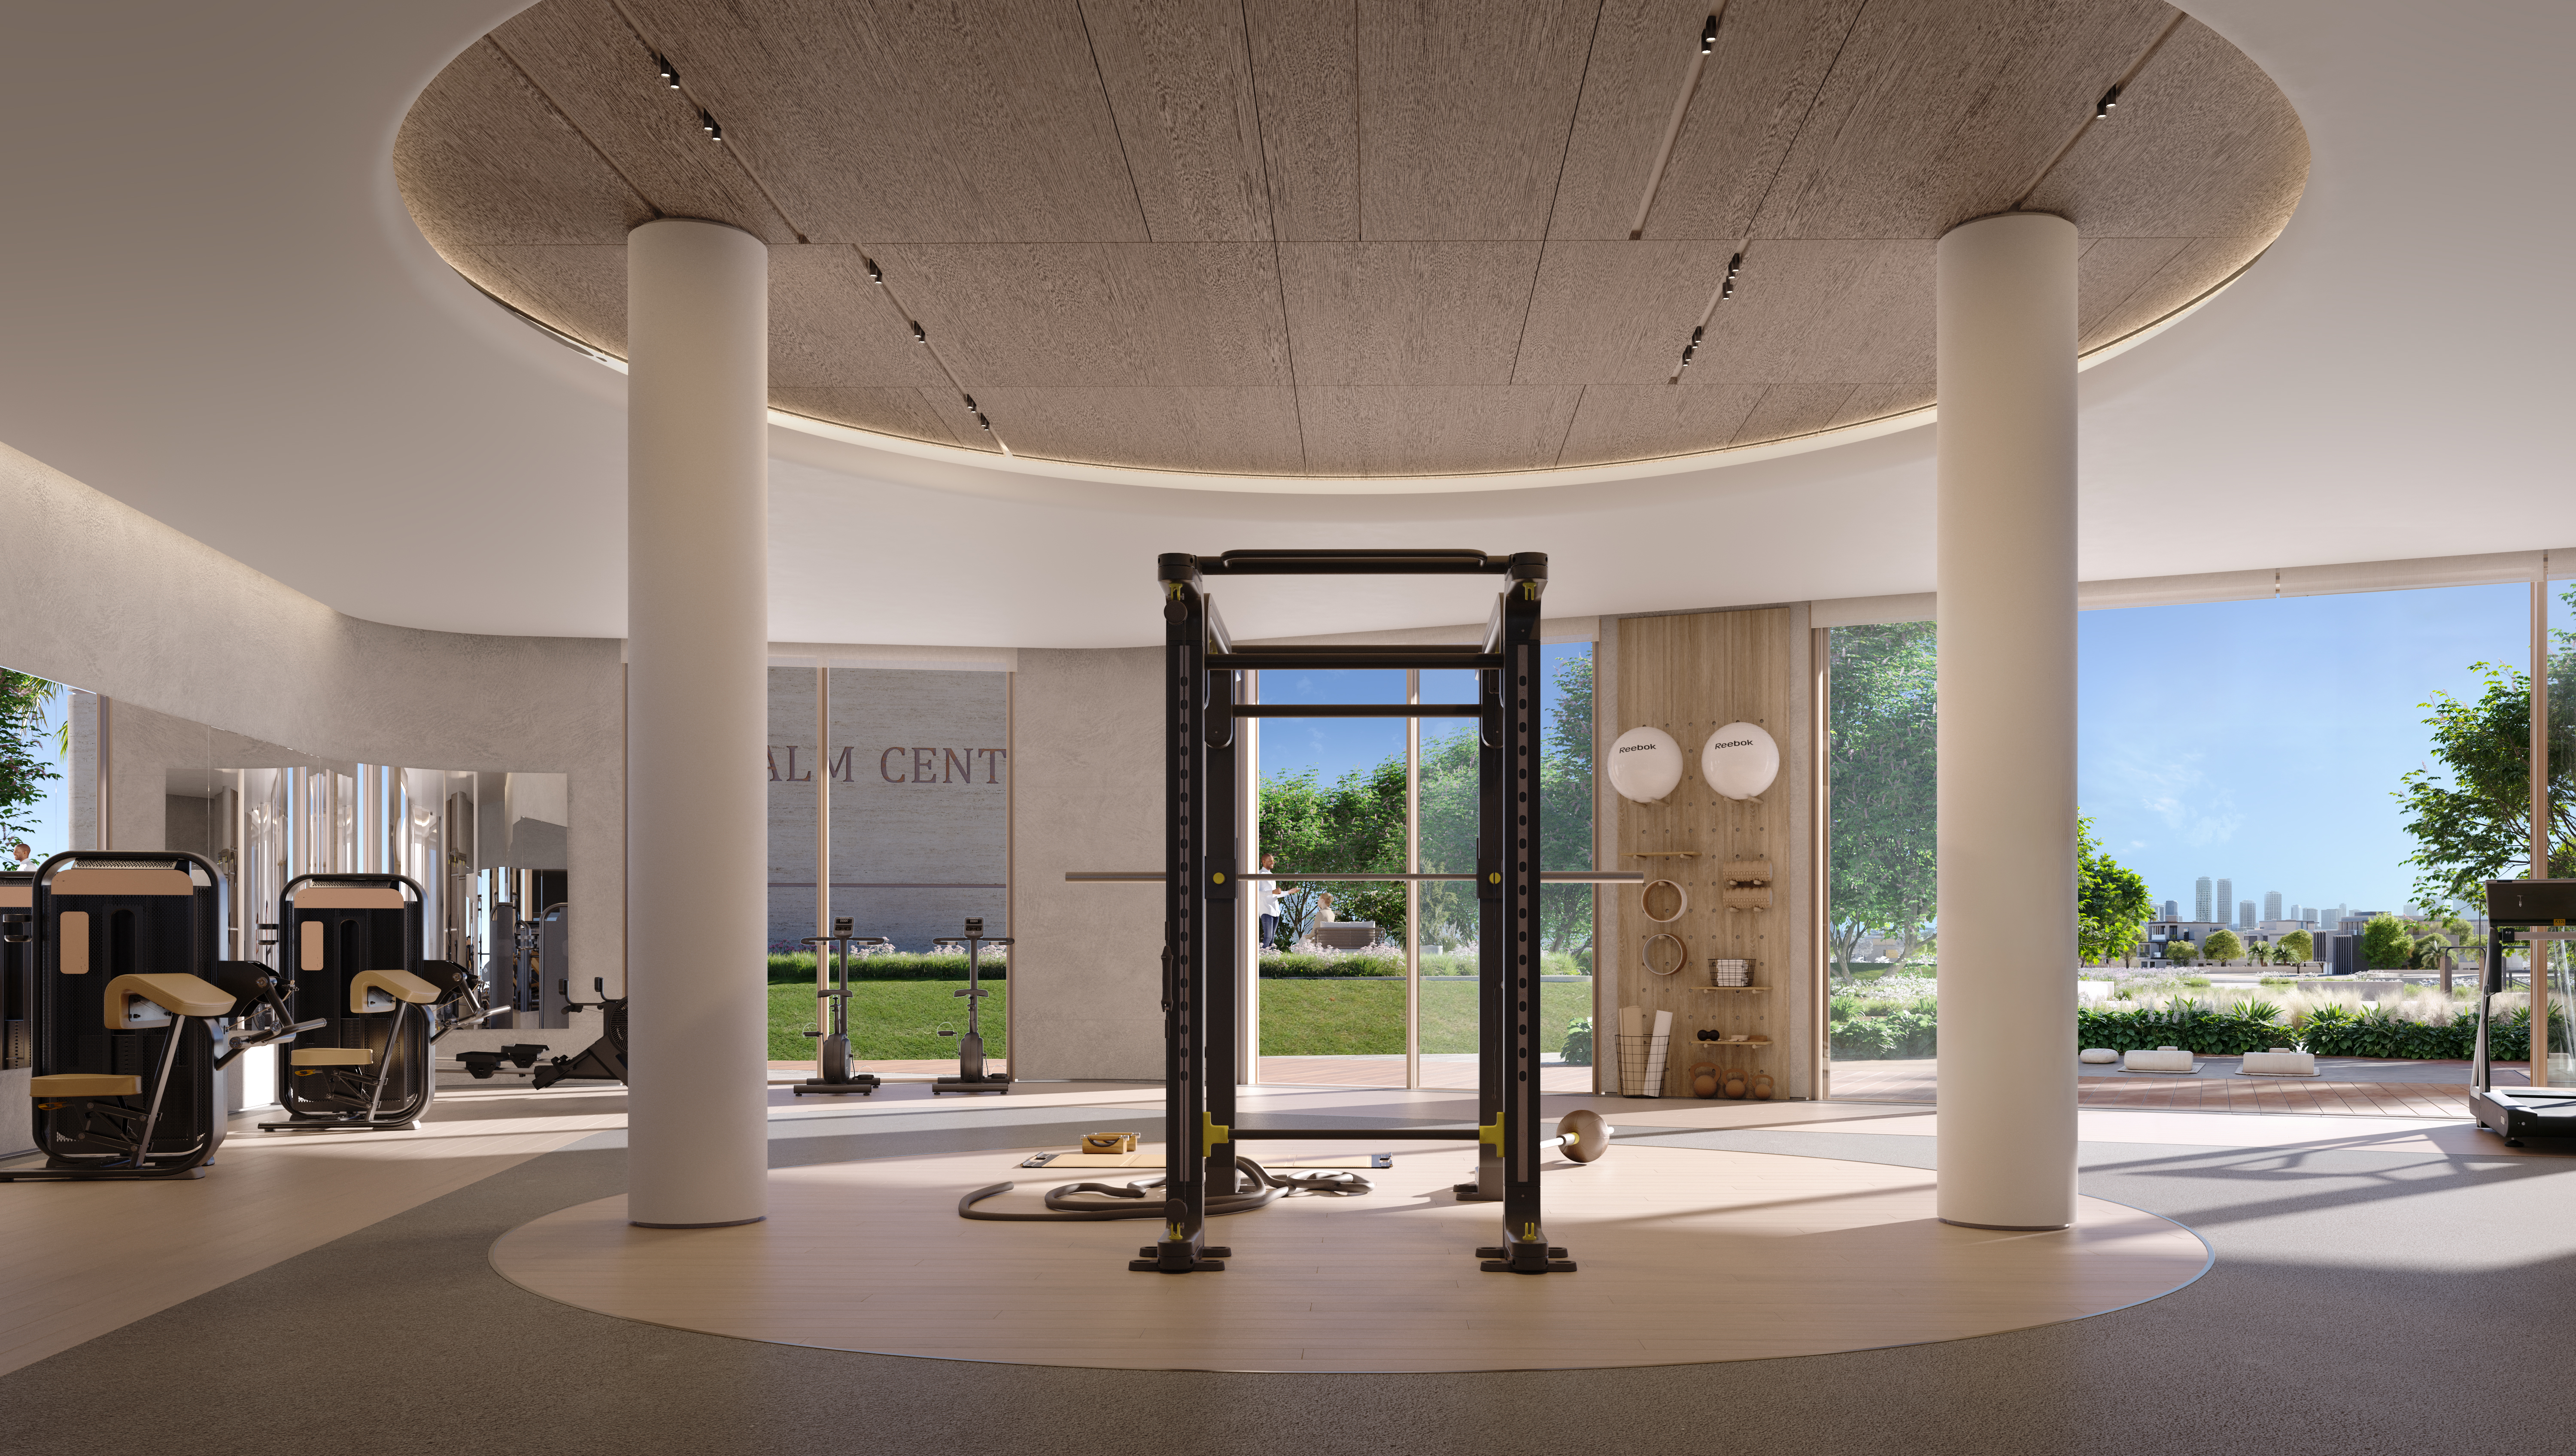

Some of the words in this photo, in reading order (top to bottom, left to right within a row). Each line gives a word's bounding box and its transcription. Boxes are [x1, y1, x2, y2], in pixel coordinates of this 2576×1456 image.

[1619, 744, 1656, 754] Reebok
[1715, 740, 1753, 749] Reebok
[881, 747, 1006, 784] CENT
